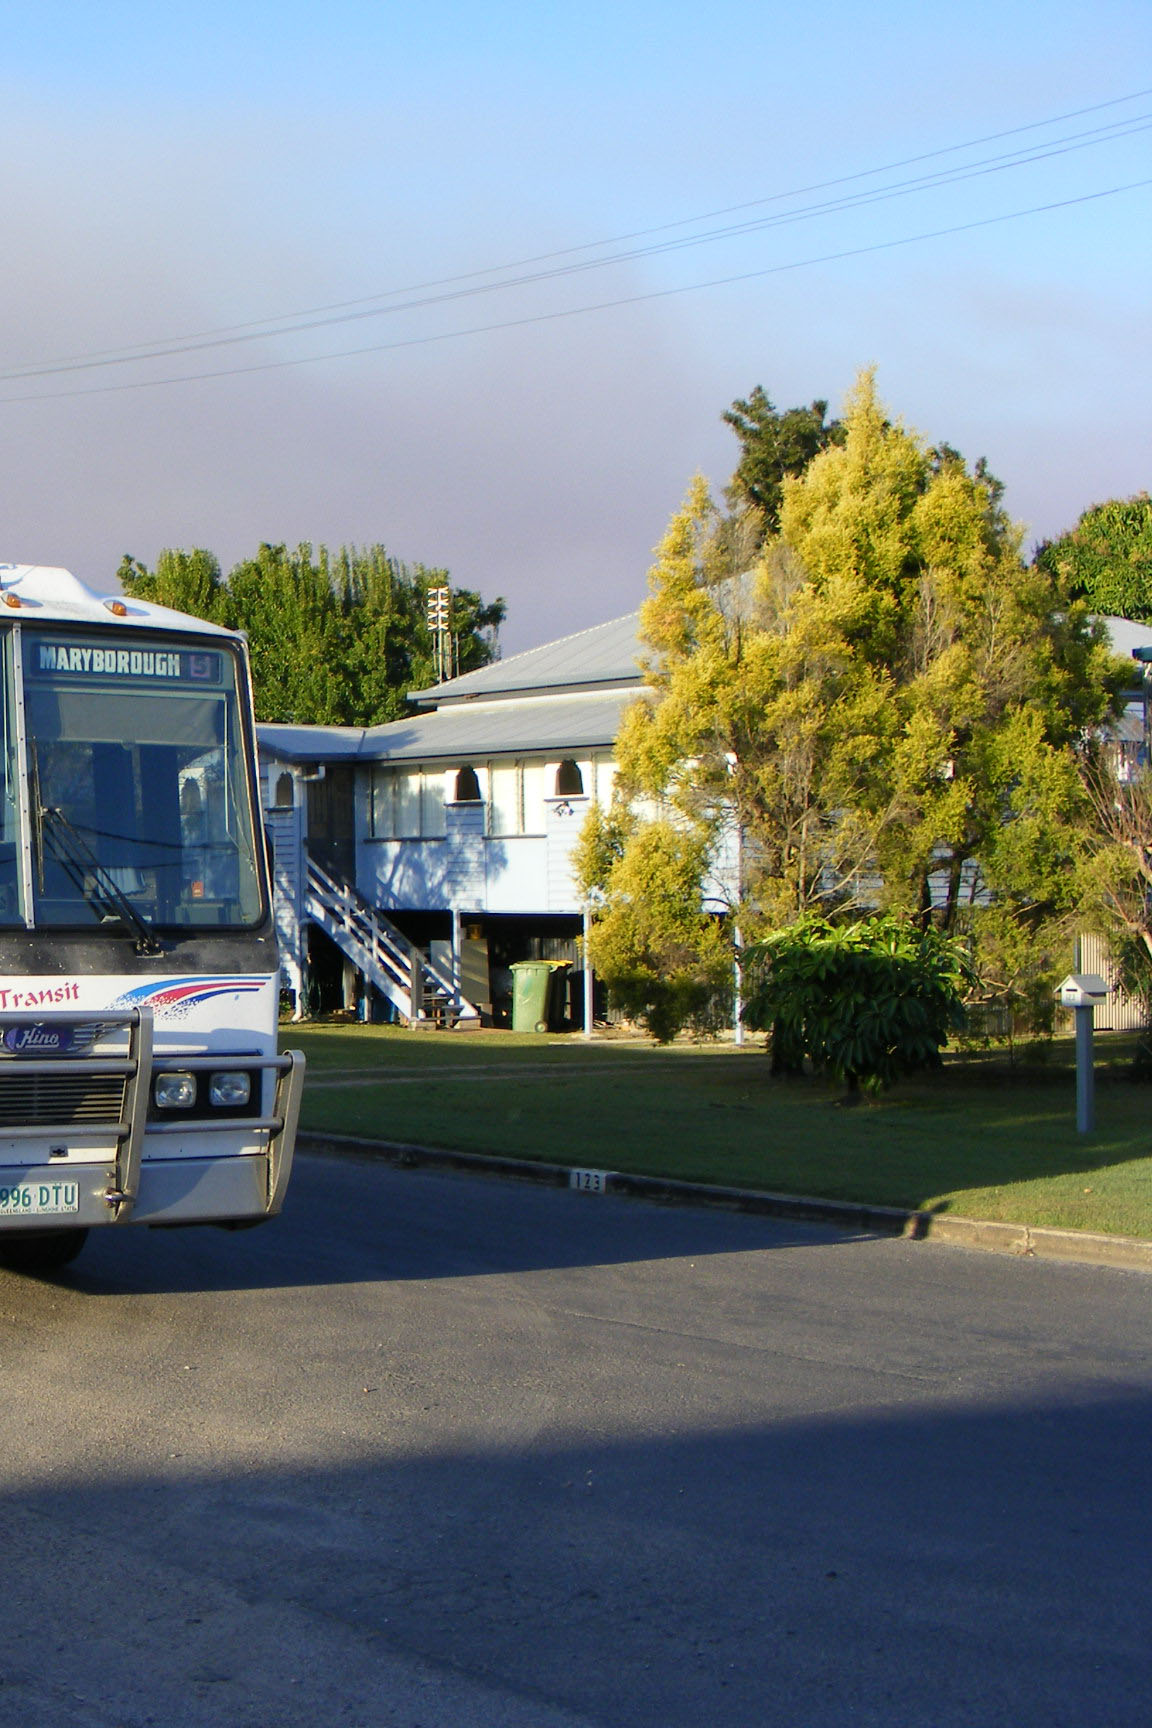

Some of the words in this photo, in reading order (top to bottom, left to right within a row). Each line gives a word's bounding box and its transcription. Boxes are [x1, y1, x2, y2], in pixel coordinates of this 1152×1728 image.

[40, 646, 181, 677] MARYBOROUGH
[16, 1027, 59, 1049] Hino
[576, 1172, 600, 1190] 123
[0, 1187, 31, 1208] 996
[38, 1185, 74, 1206] DTU
